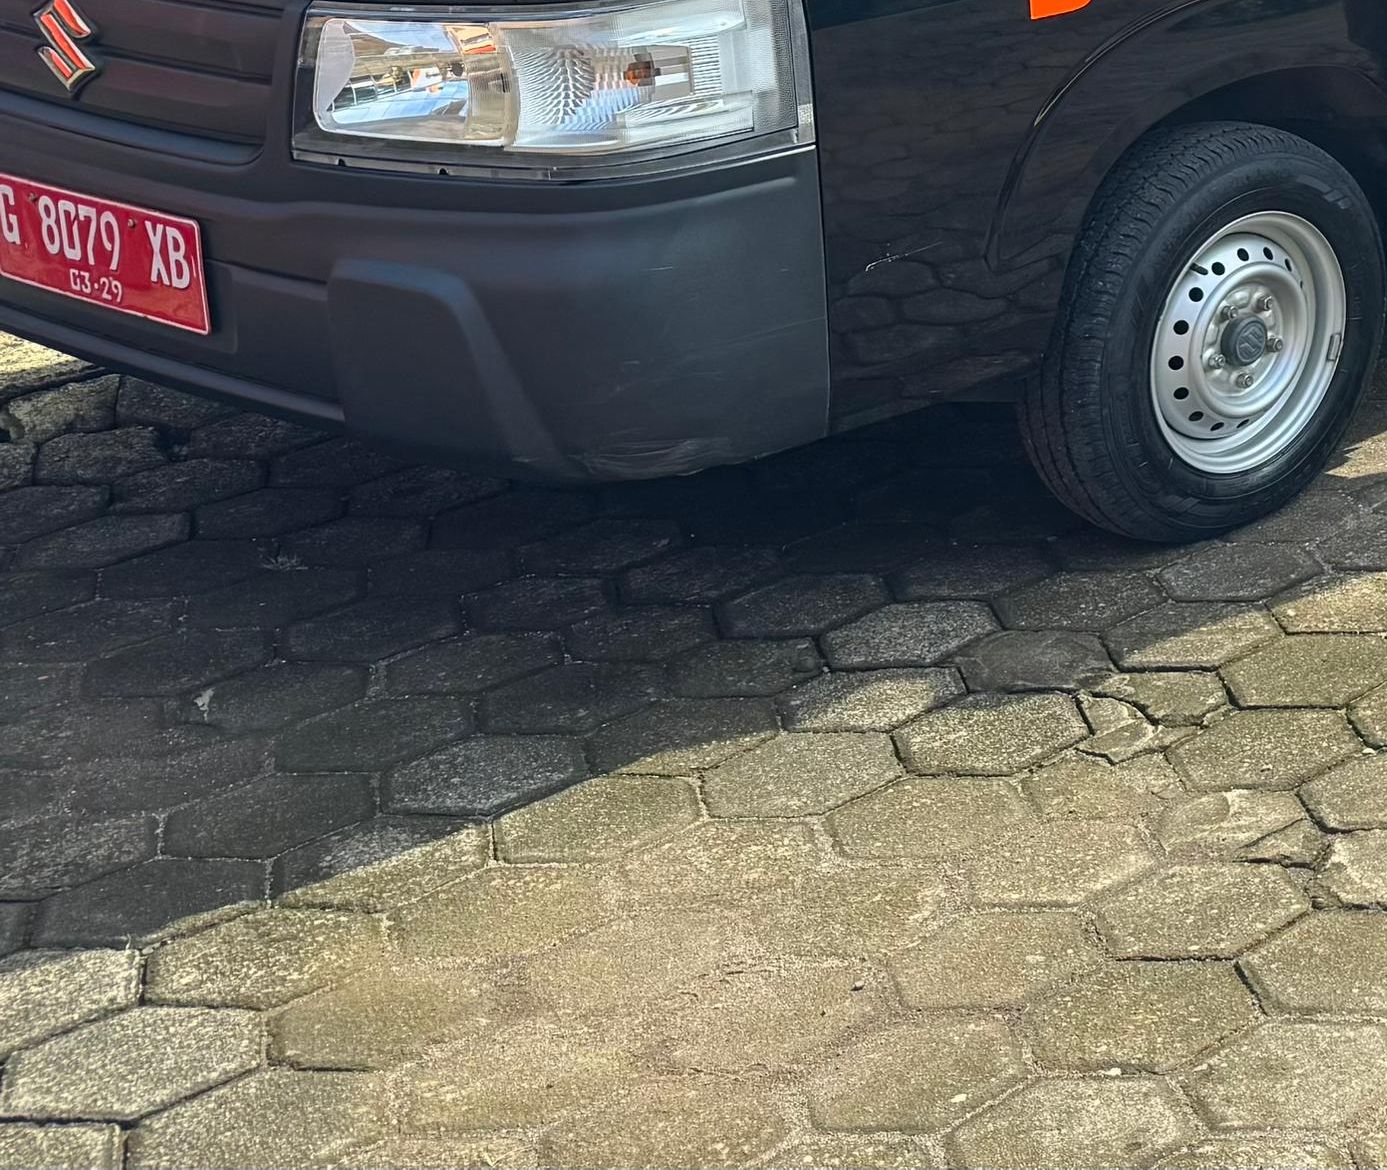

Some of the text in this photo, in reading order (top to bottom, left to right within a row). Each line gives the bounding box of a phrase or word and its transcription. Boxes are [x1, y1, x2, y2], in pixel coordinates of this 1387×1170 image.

[0, 184, 190, 289] G 8079 XB
